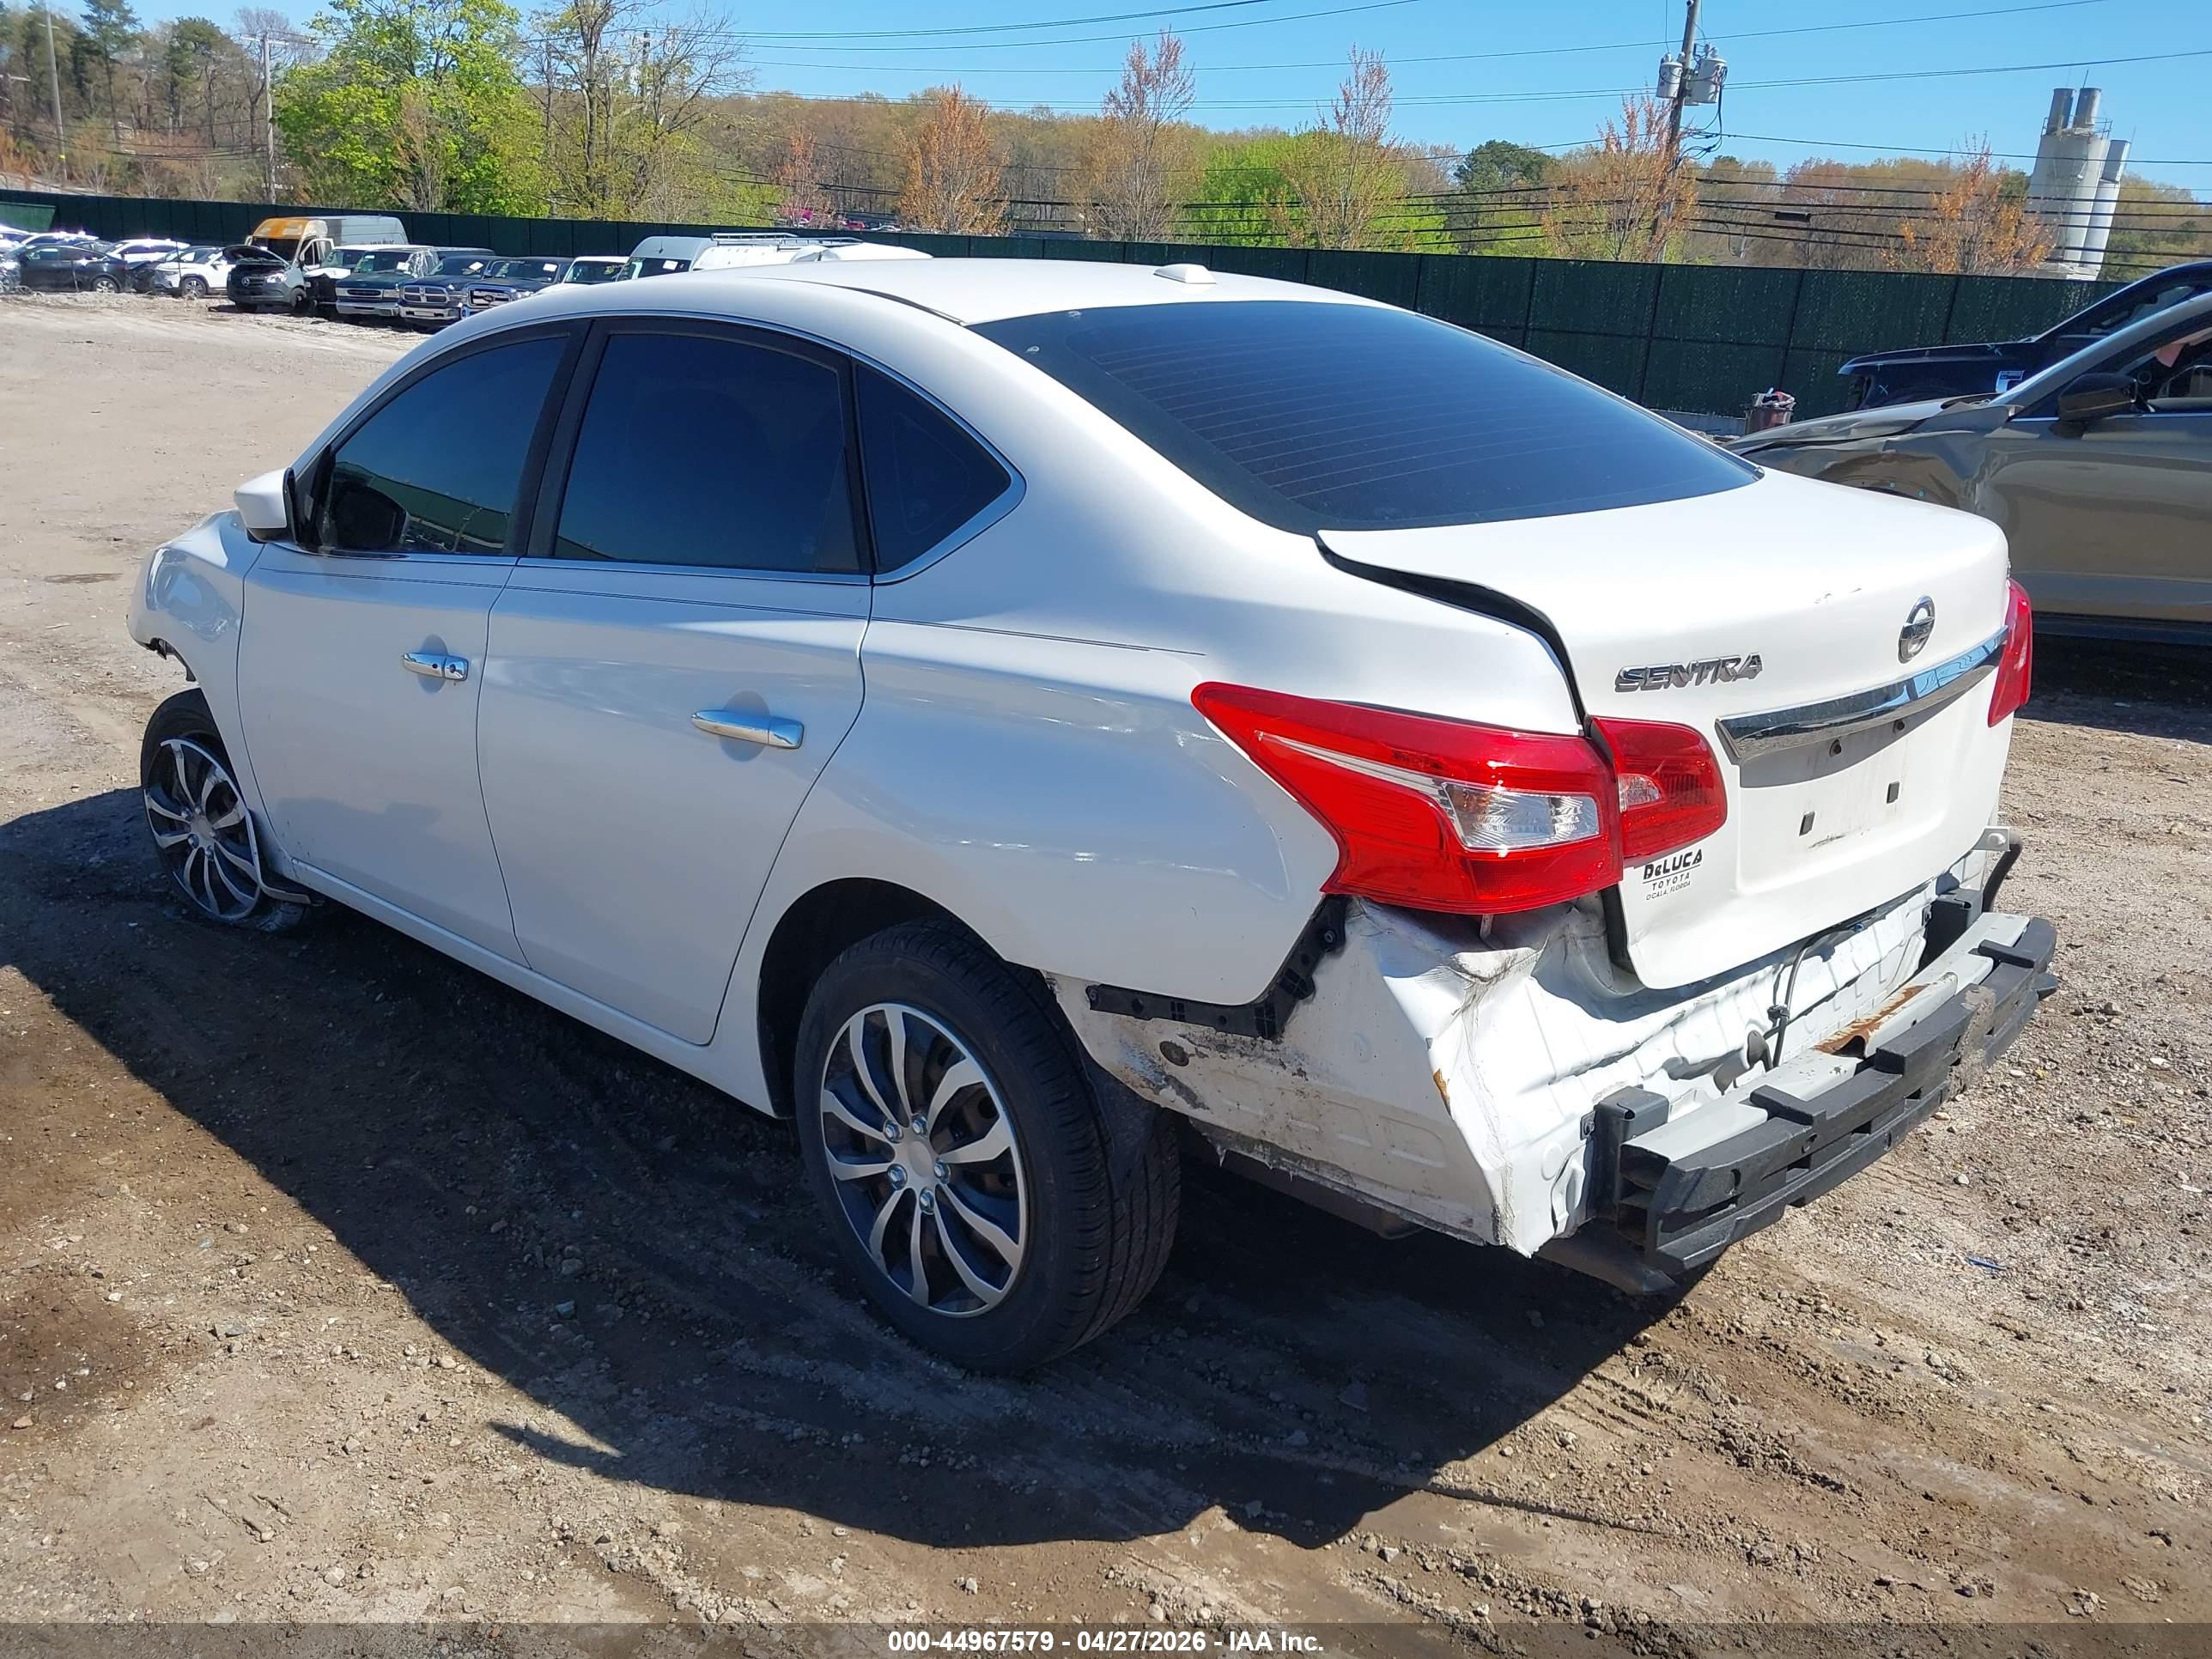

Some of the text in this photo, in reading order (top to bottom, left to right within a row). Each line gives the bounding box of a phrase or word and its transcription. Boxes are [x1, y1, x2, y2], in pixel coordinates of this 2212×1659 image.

[1615, 653, 1763, 692] SENTRA
[1644, 849, 1702, 879] DeLUCA
[1652, 872, 1690, 890] TOYOTA
